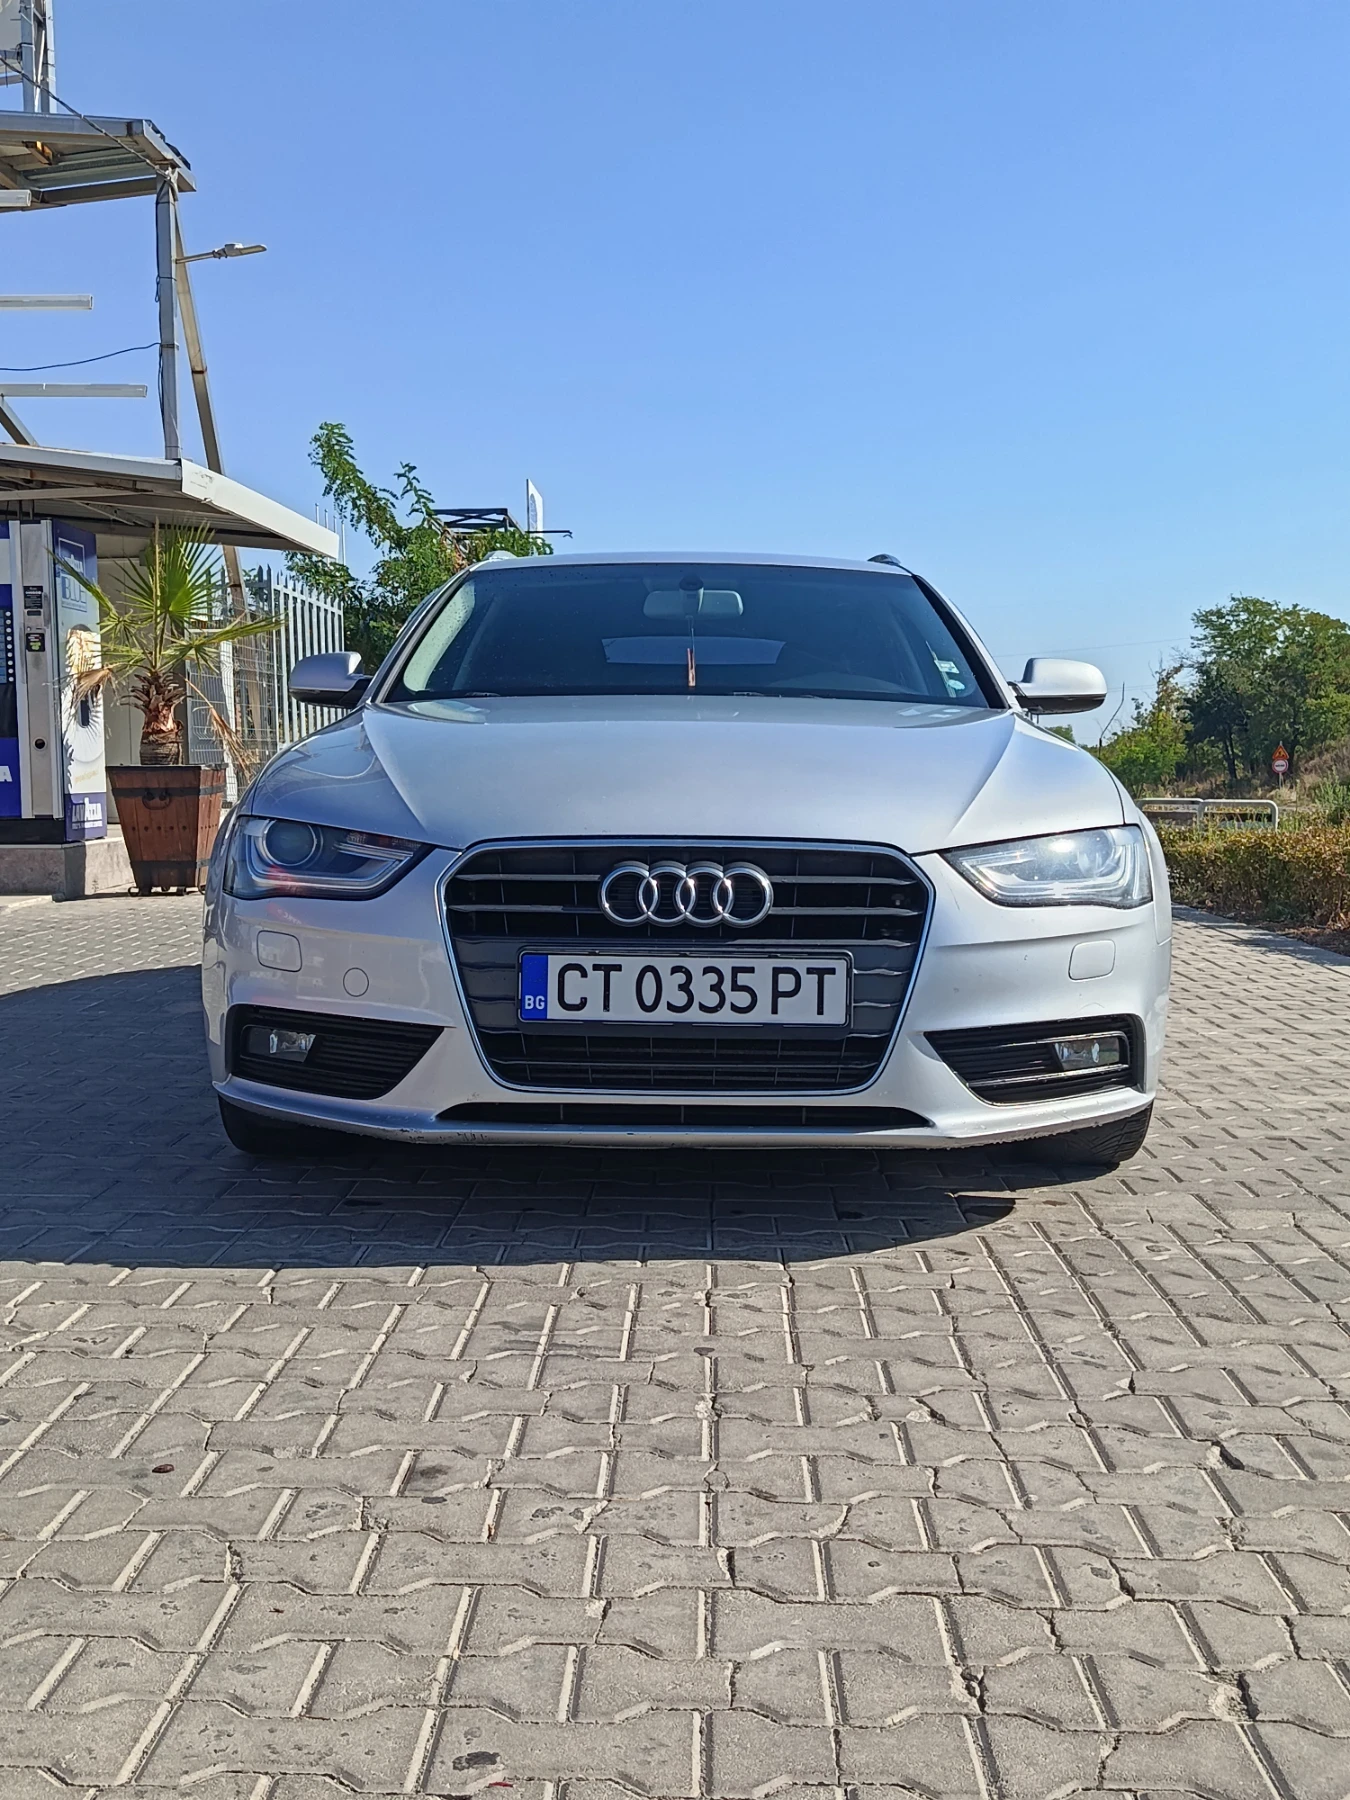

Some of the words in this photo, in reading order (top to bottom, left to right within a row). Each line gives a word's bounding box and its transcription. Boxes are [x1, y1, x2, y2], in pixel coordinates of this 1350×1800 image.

[524, 995, 545, 1010] BG
[557, 962, 622, 1013] CT
[636, 964, 758, 1014] 0335
[771, 966, 836, 1016] PT
